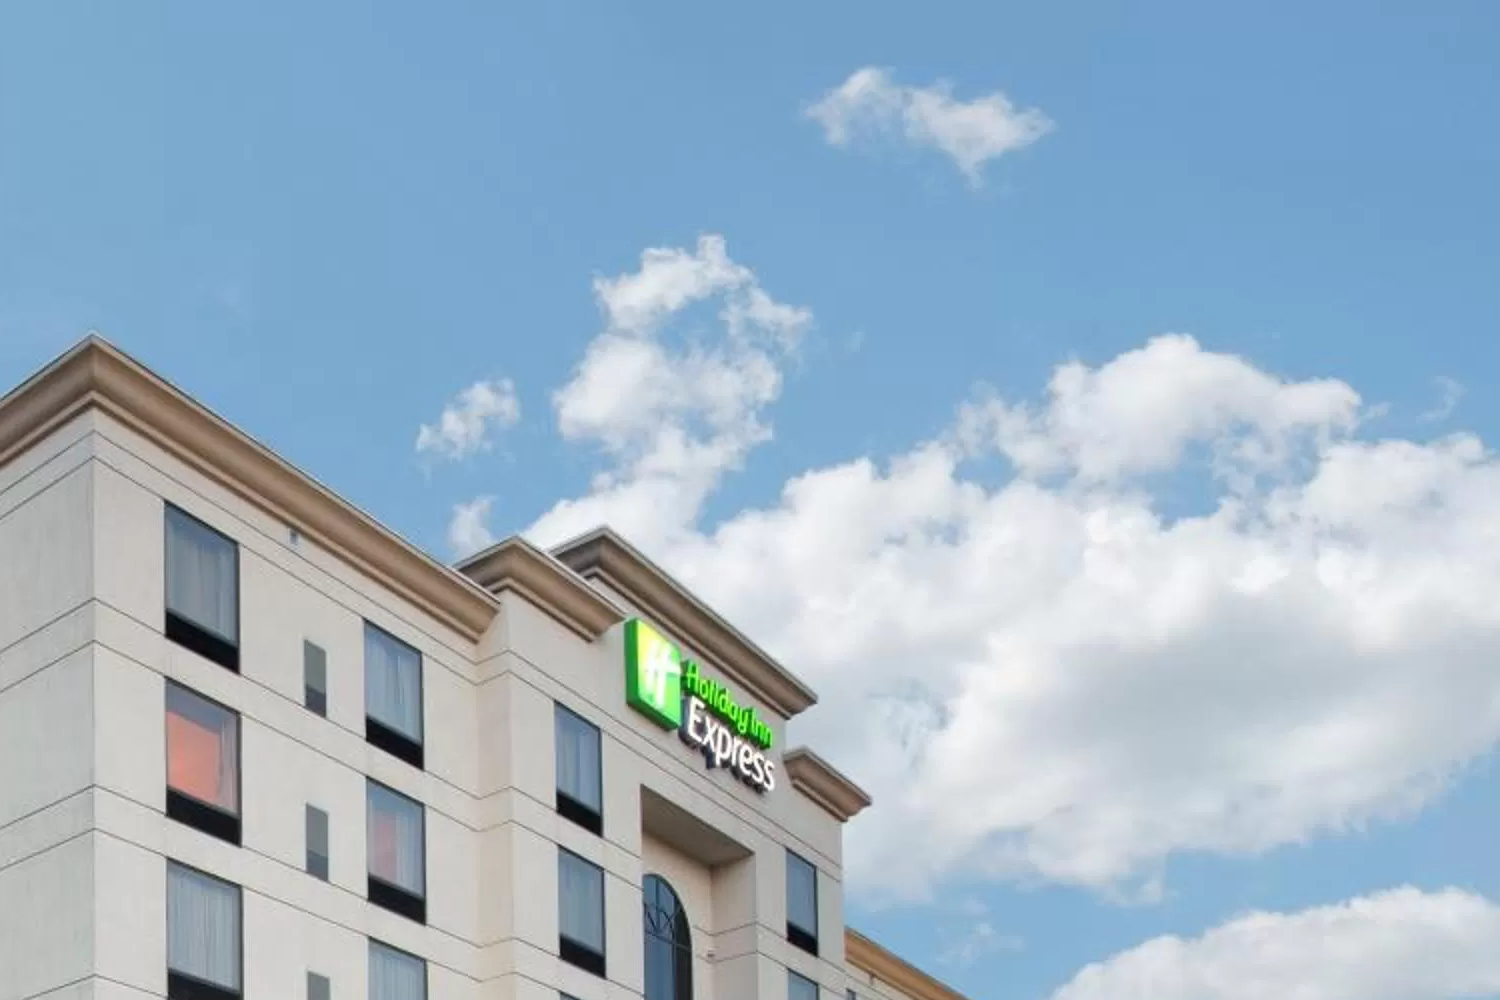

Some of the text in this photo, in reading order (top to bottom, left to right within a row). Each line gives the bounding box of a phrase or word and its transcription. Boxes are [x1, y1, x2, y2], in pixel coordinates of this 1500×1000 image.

[687, 659, 773, 747] Holiday Inn
[687, 696, 775, 791] Express
